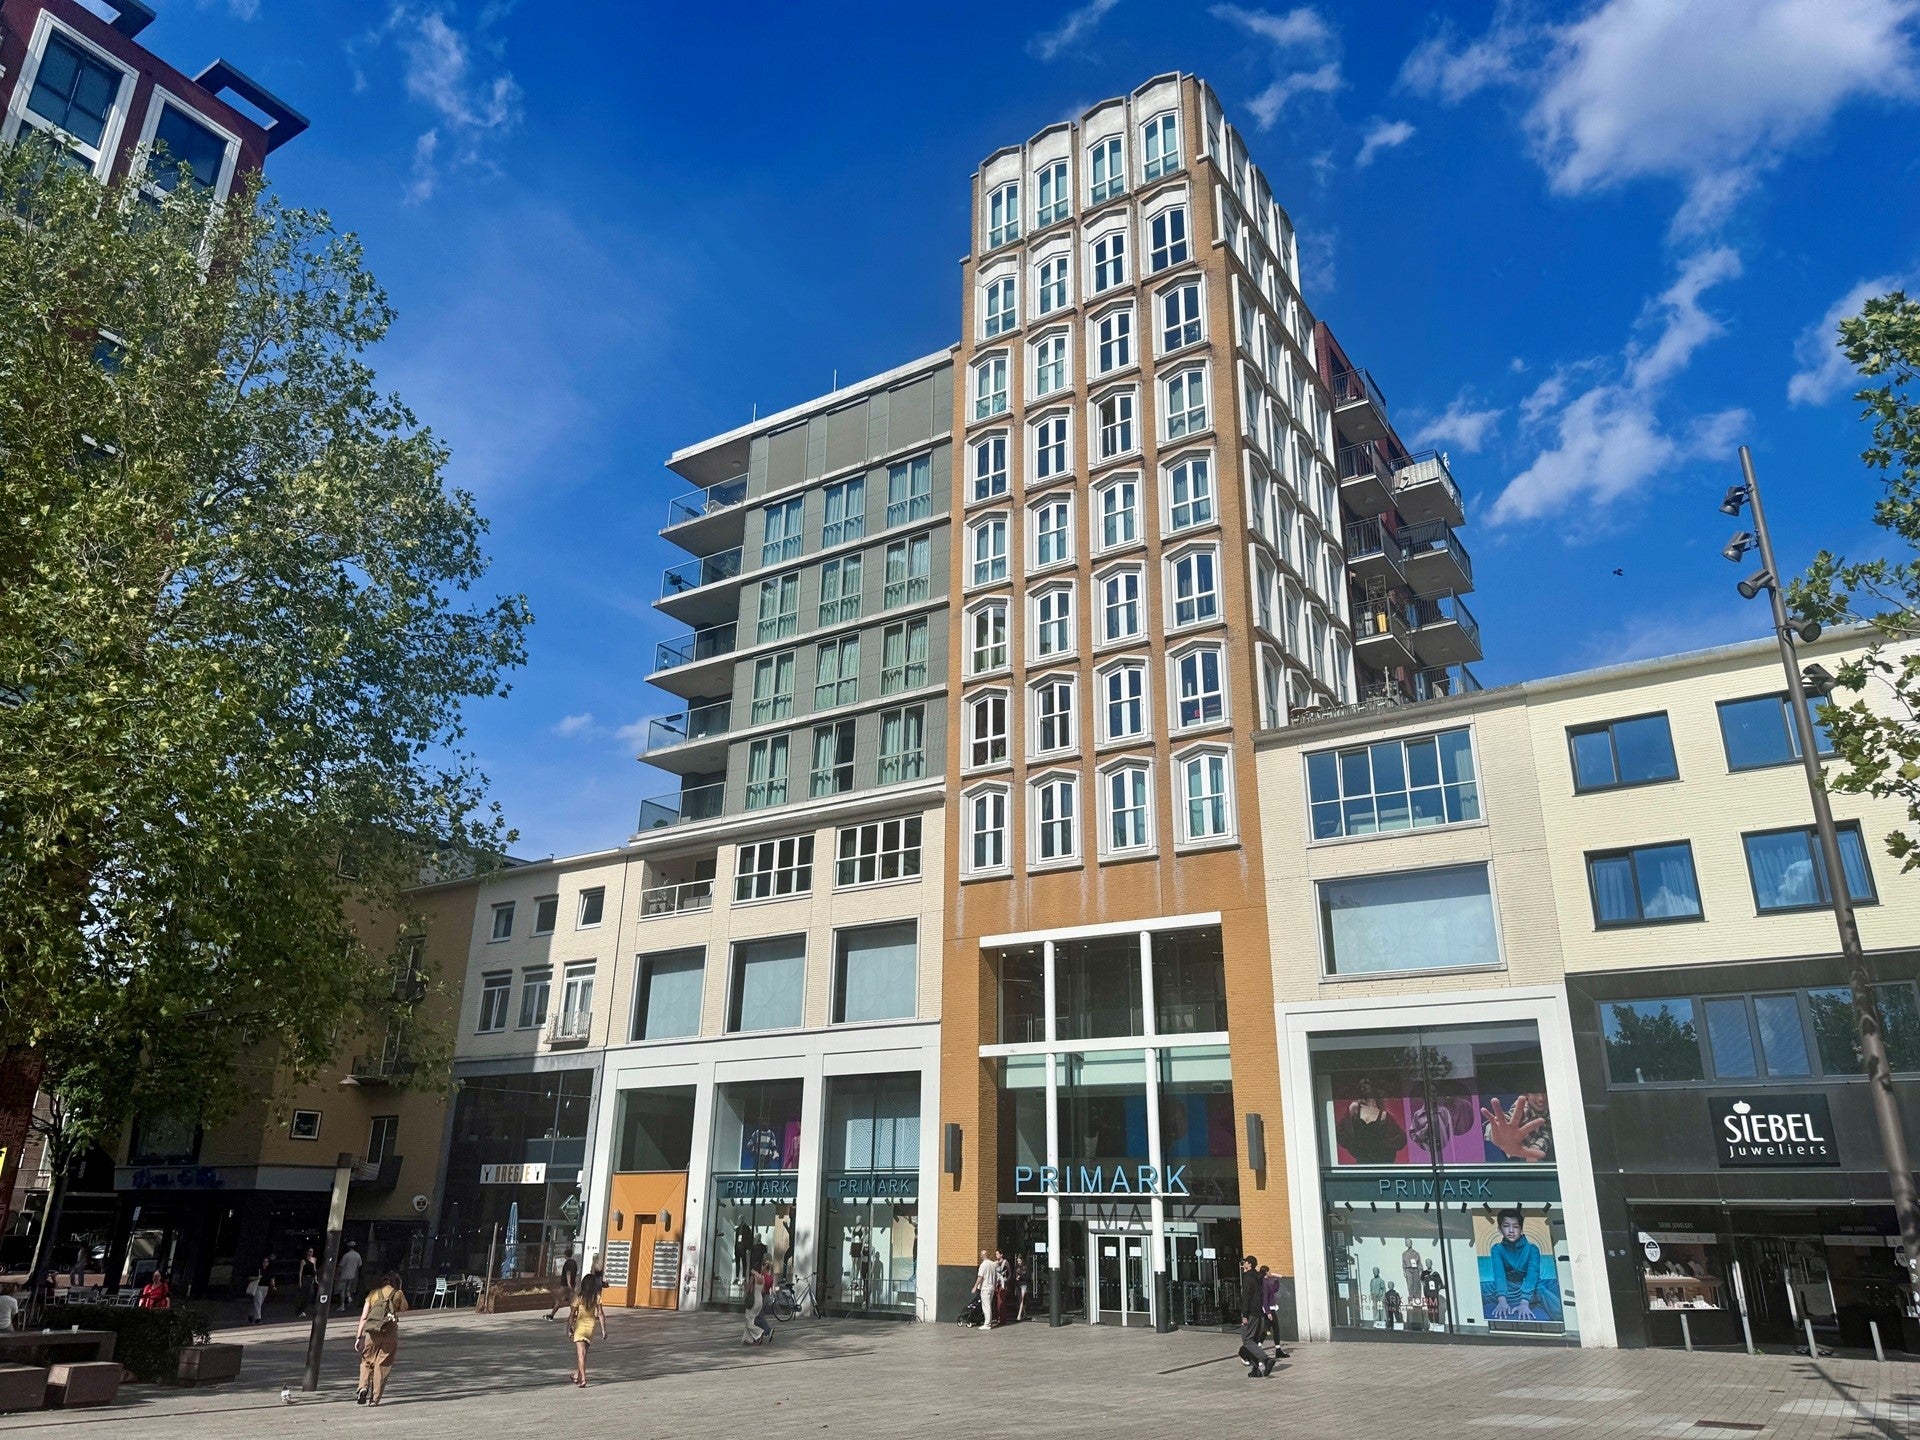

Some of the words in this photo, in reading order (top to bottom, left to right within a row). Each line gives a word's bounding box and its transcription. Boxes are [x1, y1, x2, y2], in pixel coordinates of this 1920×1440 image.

[1723, 1113, 1825, 1143] SIEBEL
[1729, 1143, 1827, 1158] Juweliers
[726, 1180, 791, 1194] PRIMARK
[838, 1179, 910, 1194] PRIMARK
[1015, 1165, 1189, 1194] PRIMARK
[1378, 1179, 1492, 1196] PRIMARK
